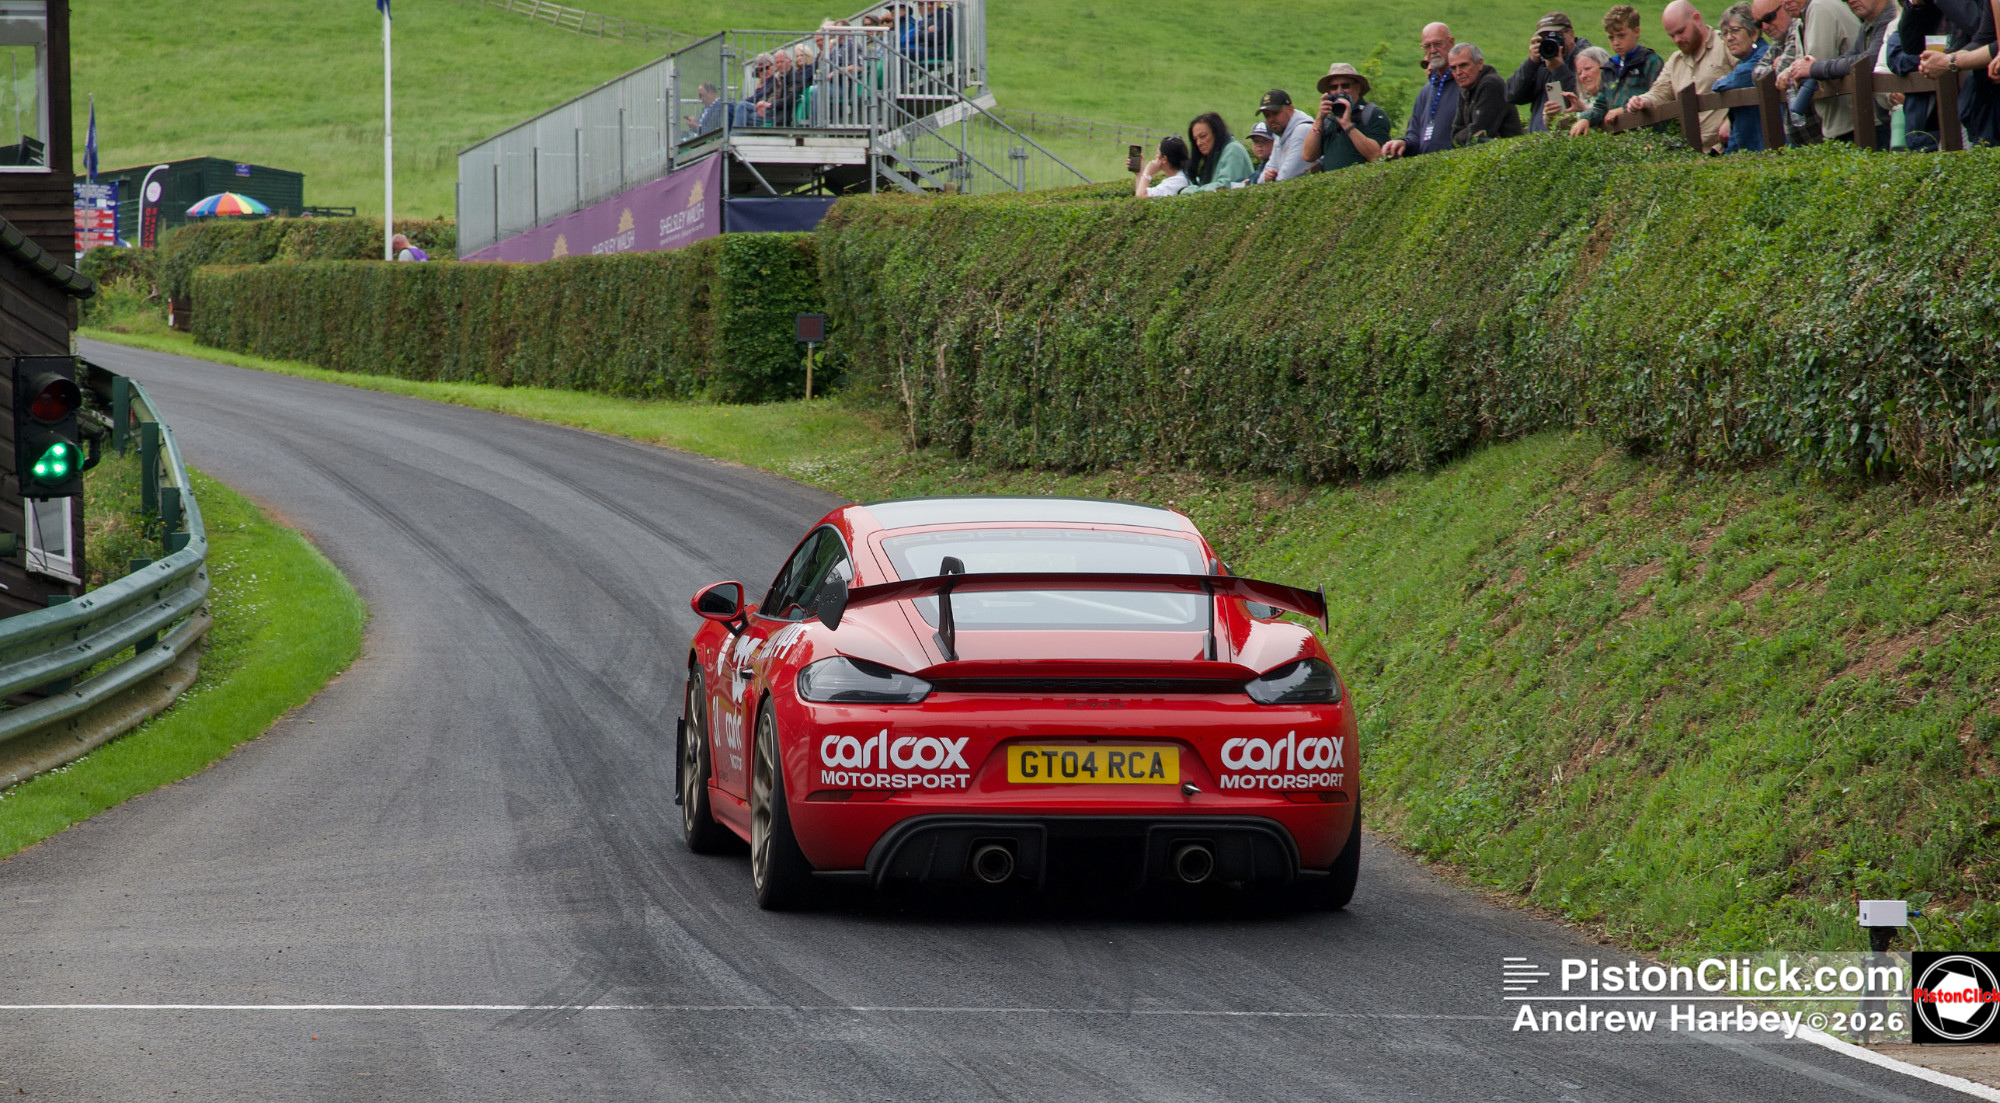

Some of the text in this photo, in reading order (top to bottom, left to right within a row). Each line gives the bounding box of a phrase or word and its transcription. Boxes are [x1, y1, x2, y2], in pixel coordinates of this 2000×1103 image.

[1021, 750, 1165, 779] GT04 RCA
[821, 770, 970, 789] MOTORSPORT
[1220, 773, 1343, 789] MOTORSPORT
